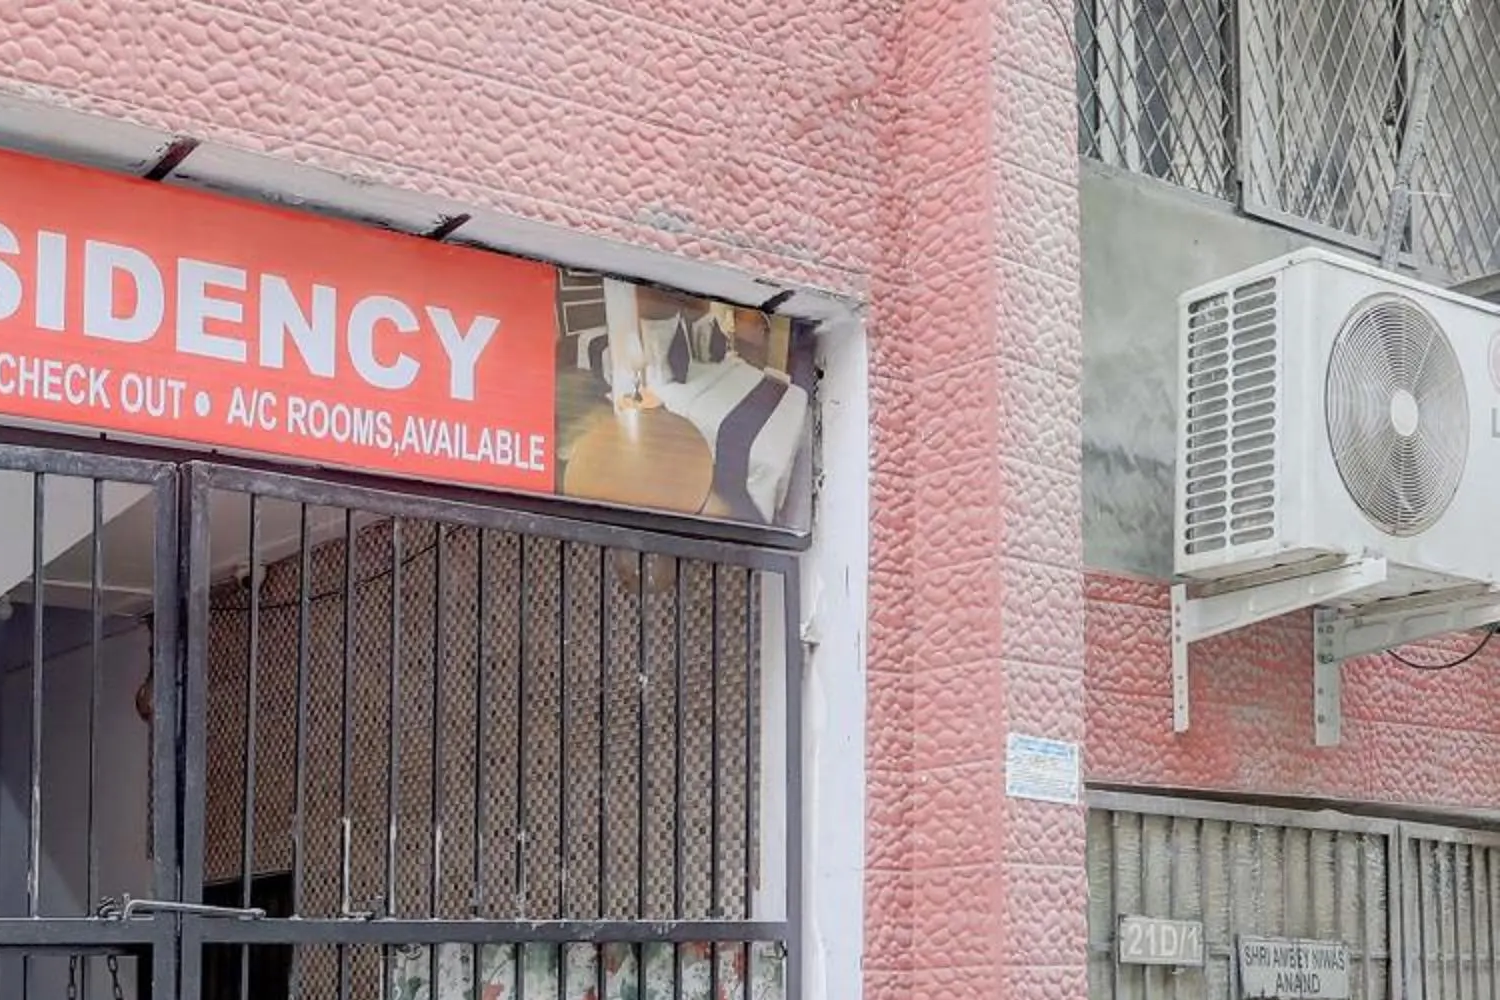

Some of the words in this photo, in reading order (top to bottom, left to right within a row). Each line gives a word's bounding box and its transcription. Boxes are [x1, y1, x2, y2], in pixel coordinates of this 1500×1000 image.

[119, 371, 188, 420] OUT
[227, 385, 278, 432] A/C
[1276, 972, 1321, 993] ANAND
